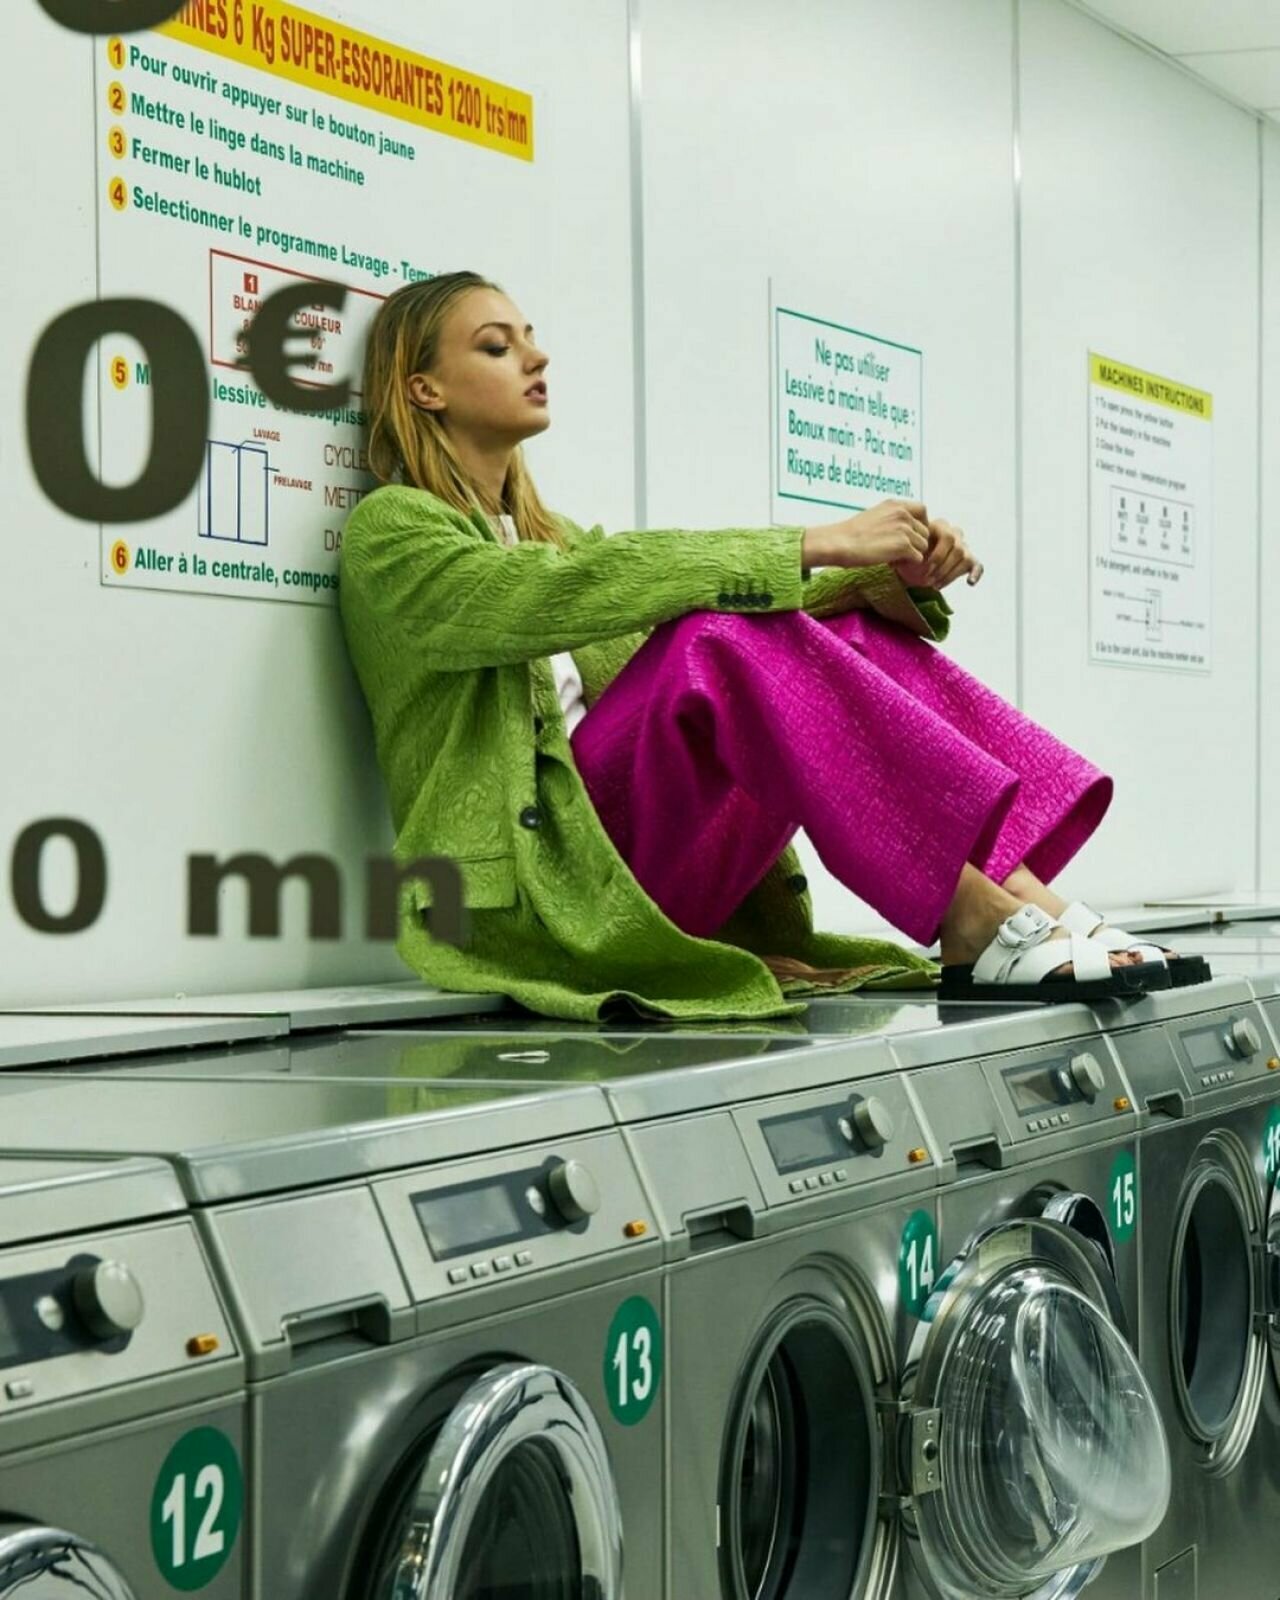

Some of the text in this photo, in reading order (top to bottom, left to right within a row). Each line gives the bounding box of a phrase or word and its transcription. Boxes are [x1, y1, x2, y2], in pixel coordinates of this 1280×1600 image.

[233, 0, 244, 45] 6
[252, 4, 275, 65] Kg
[280, 16, 444, 117] SUPER-ESSORANTES
[448, 77, 482, 130] 1200
[112, 42, 415, 160] 1 Pour ouvrir appuyer sur le bouton jaune
[112, 87, 365, 186] 2 Mettre le linge dans la machine
[112, 131, 262, 196] 3 Fermer le hublot
[112, 182, 123, 205] 4
[133, 185, 234, 233] Selectionner
[239, 215, 252, 238] le
[256, 225, 338, 262] programme
[341, 244, 389, 278] Lavage
[294, 311, 342, 335] COULEUR
[115, 361, 126, 384] 5
[213, 378, 267, 409] lessive
[815, 337, 891, 383] Ne pas utiliser
[1098, 363, 1145, 394] MACHINES
[1146, 381, 1205, 415] INSTRUCTIONS
[785, 368, 825, 403] Lessive
[838, 386, 865, 413] main
[867, 390, 889, 420] telle
[890, 401, 910, 430] que
[788, 408, 825, 442] Bonux
[827, 422, 856, 448] main
[888, 436, 913, 462] main
[786, 448, 825, 485] Risque
[827, 454, 842, 483] de
[115, 546, 340, 593] 6 Aller à la centrale, compos
[1112, 1171, 1135, 1229] 15
[905, 1233, 935, 1301] 14
[611, 1325, 653, 1406] 13
[161, 1463, 225, 1568] 12
